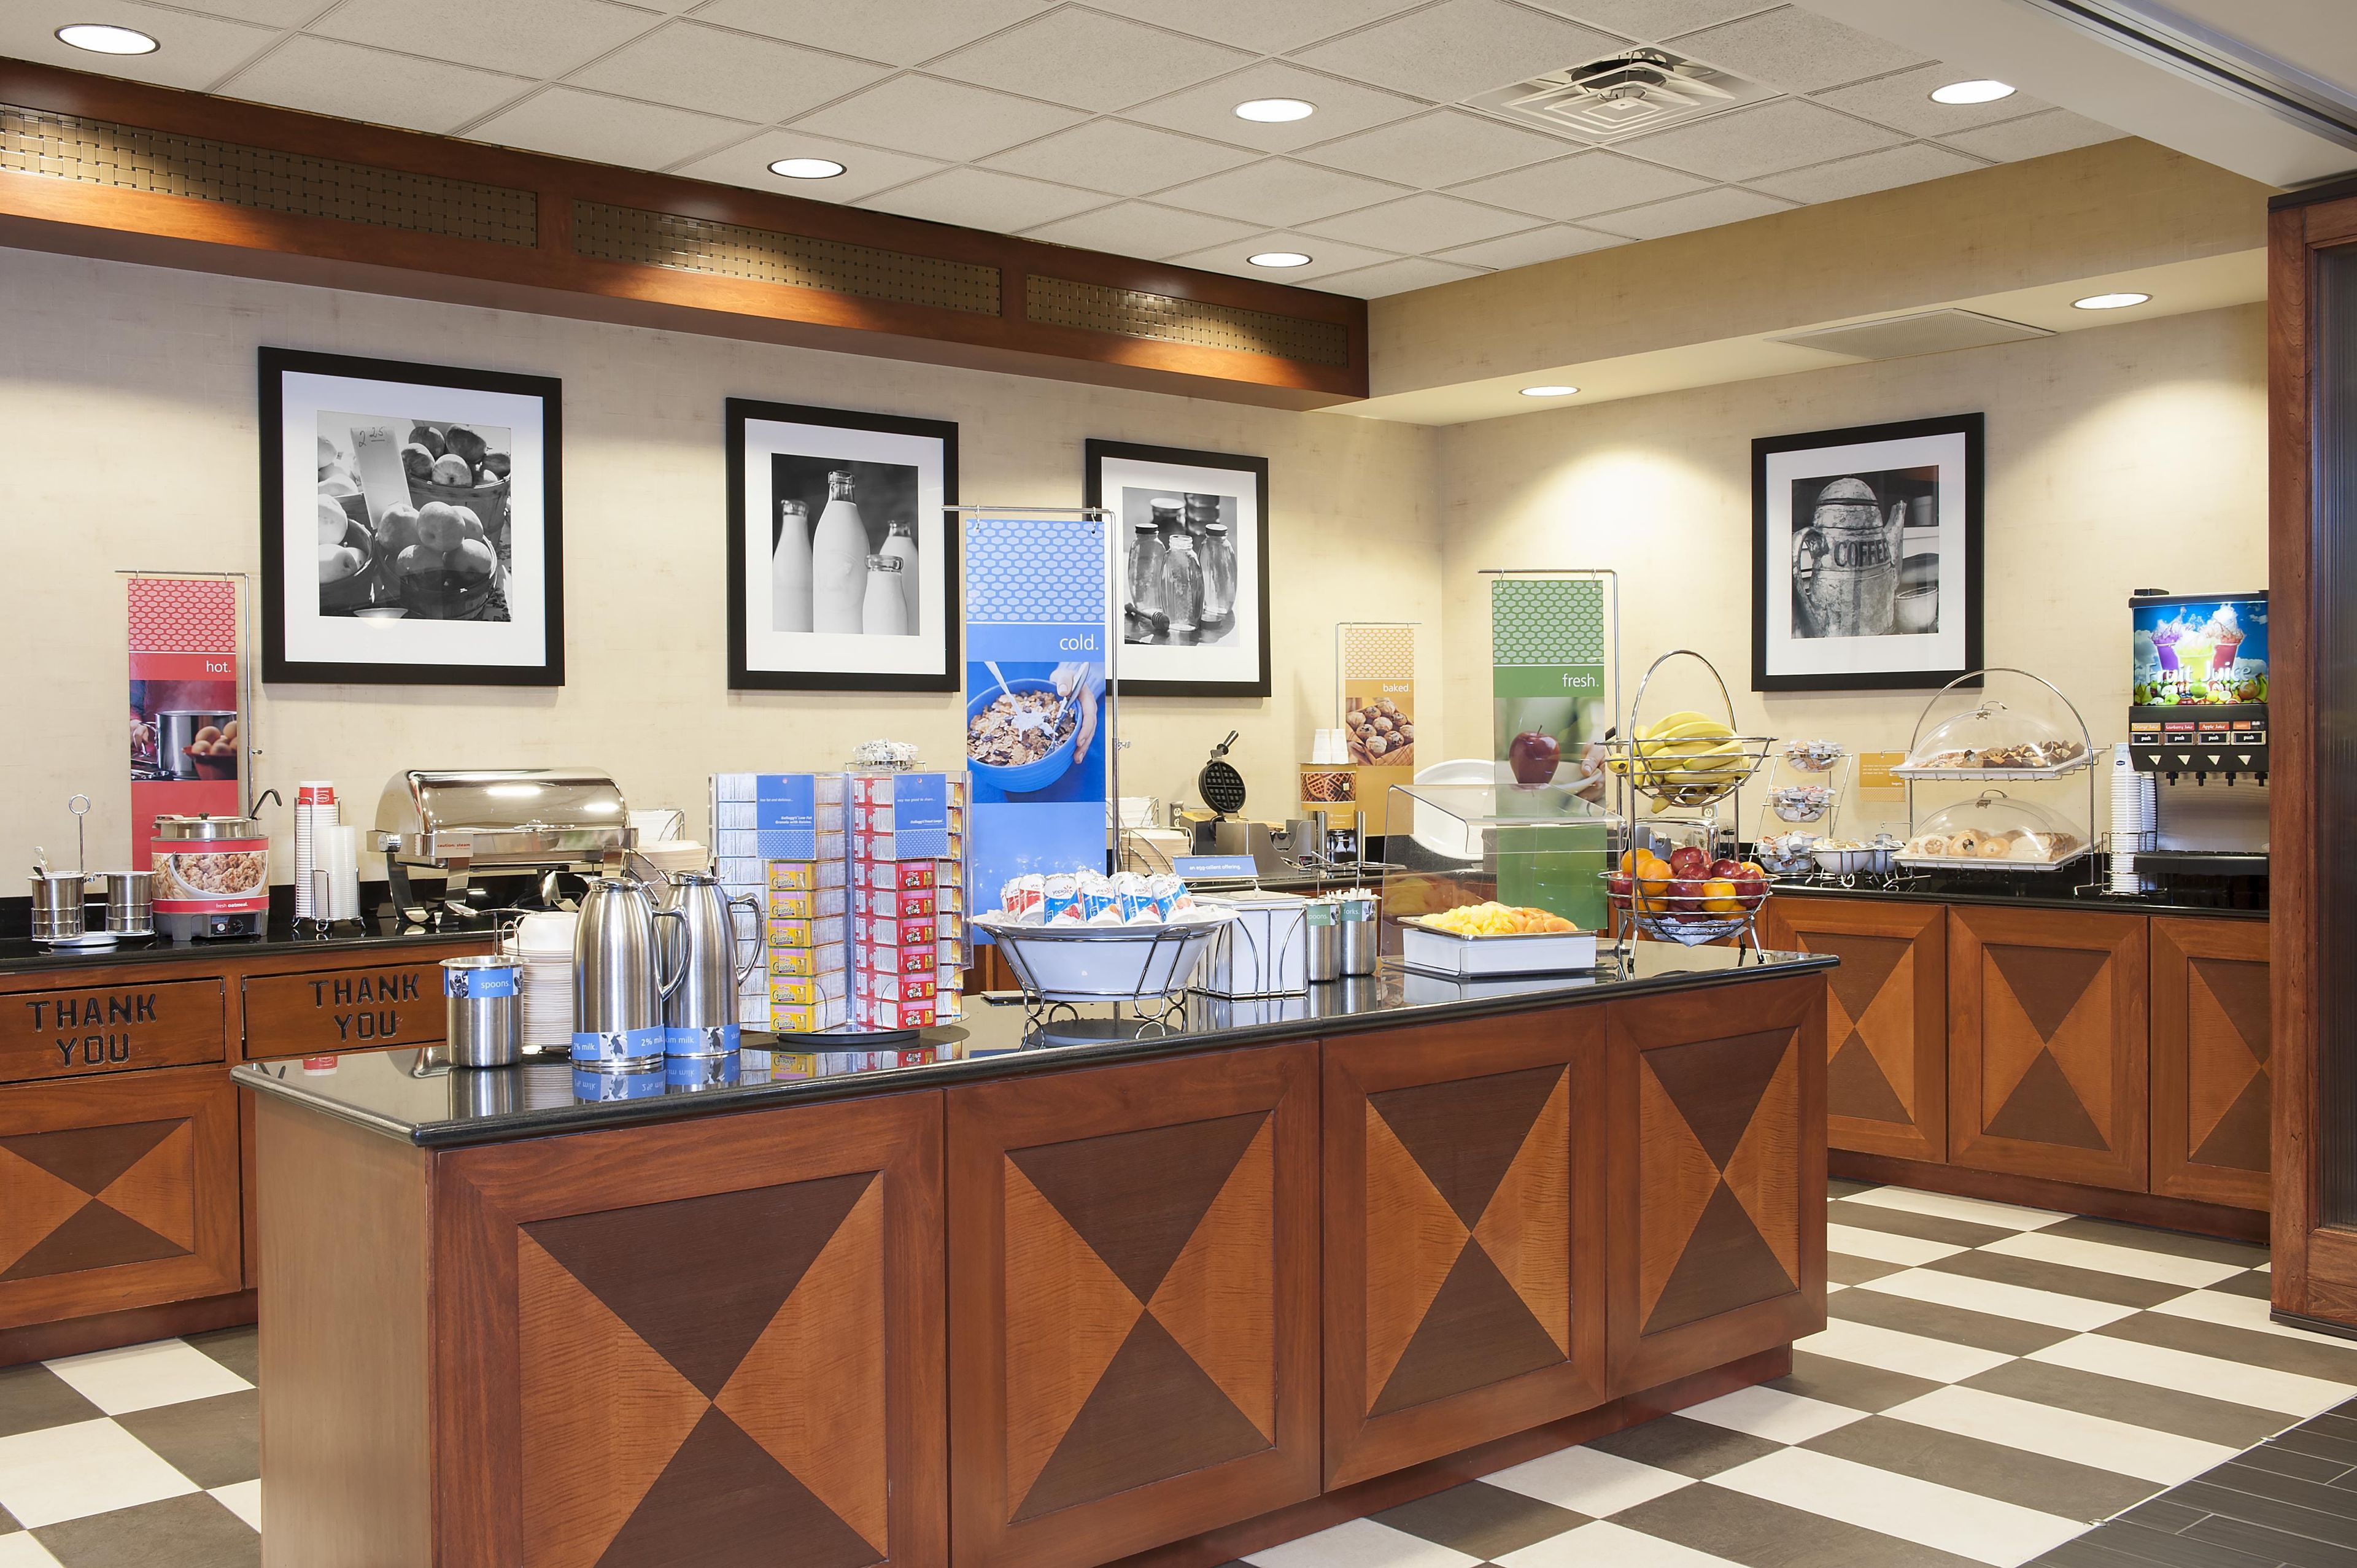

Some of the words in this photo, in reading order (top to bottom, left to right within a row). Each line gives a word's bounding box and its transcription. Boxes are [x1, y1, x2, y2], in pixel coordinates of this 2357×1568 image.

[1059, 633, 1099, 651] cold.
[206, 660, 231, 673] hot.
[2145, 663, 2194, 684] Fruit
[2202, 660, 2252, 682] Juice
[1562, 673, 1599, 687] fresh.
[1383, 683, 1411, 692] baked.
[308, 973, 420, 1009] THANK
[481, 980, 511, 990] spoons.
[772, 990, 795, 1000] Granola
[26, 992, 157, 1032] THANK
[334, 1010, 397, 1041] YOU
[773, 1018, 795, 1029] Granola
[581, 1042, 598, 1051] milk.
[641, 1038, 653, 1046] 2%
[56, 1033, 130, 1068] YOU
